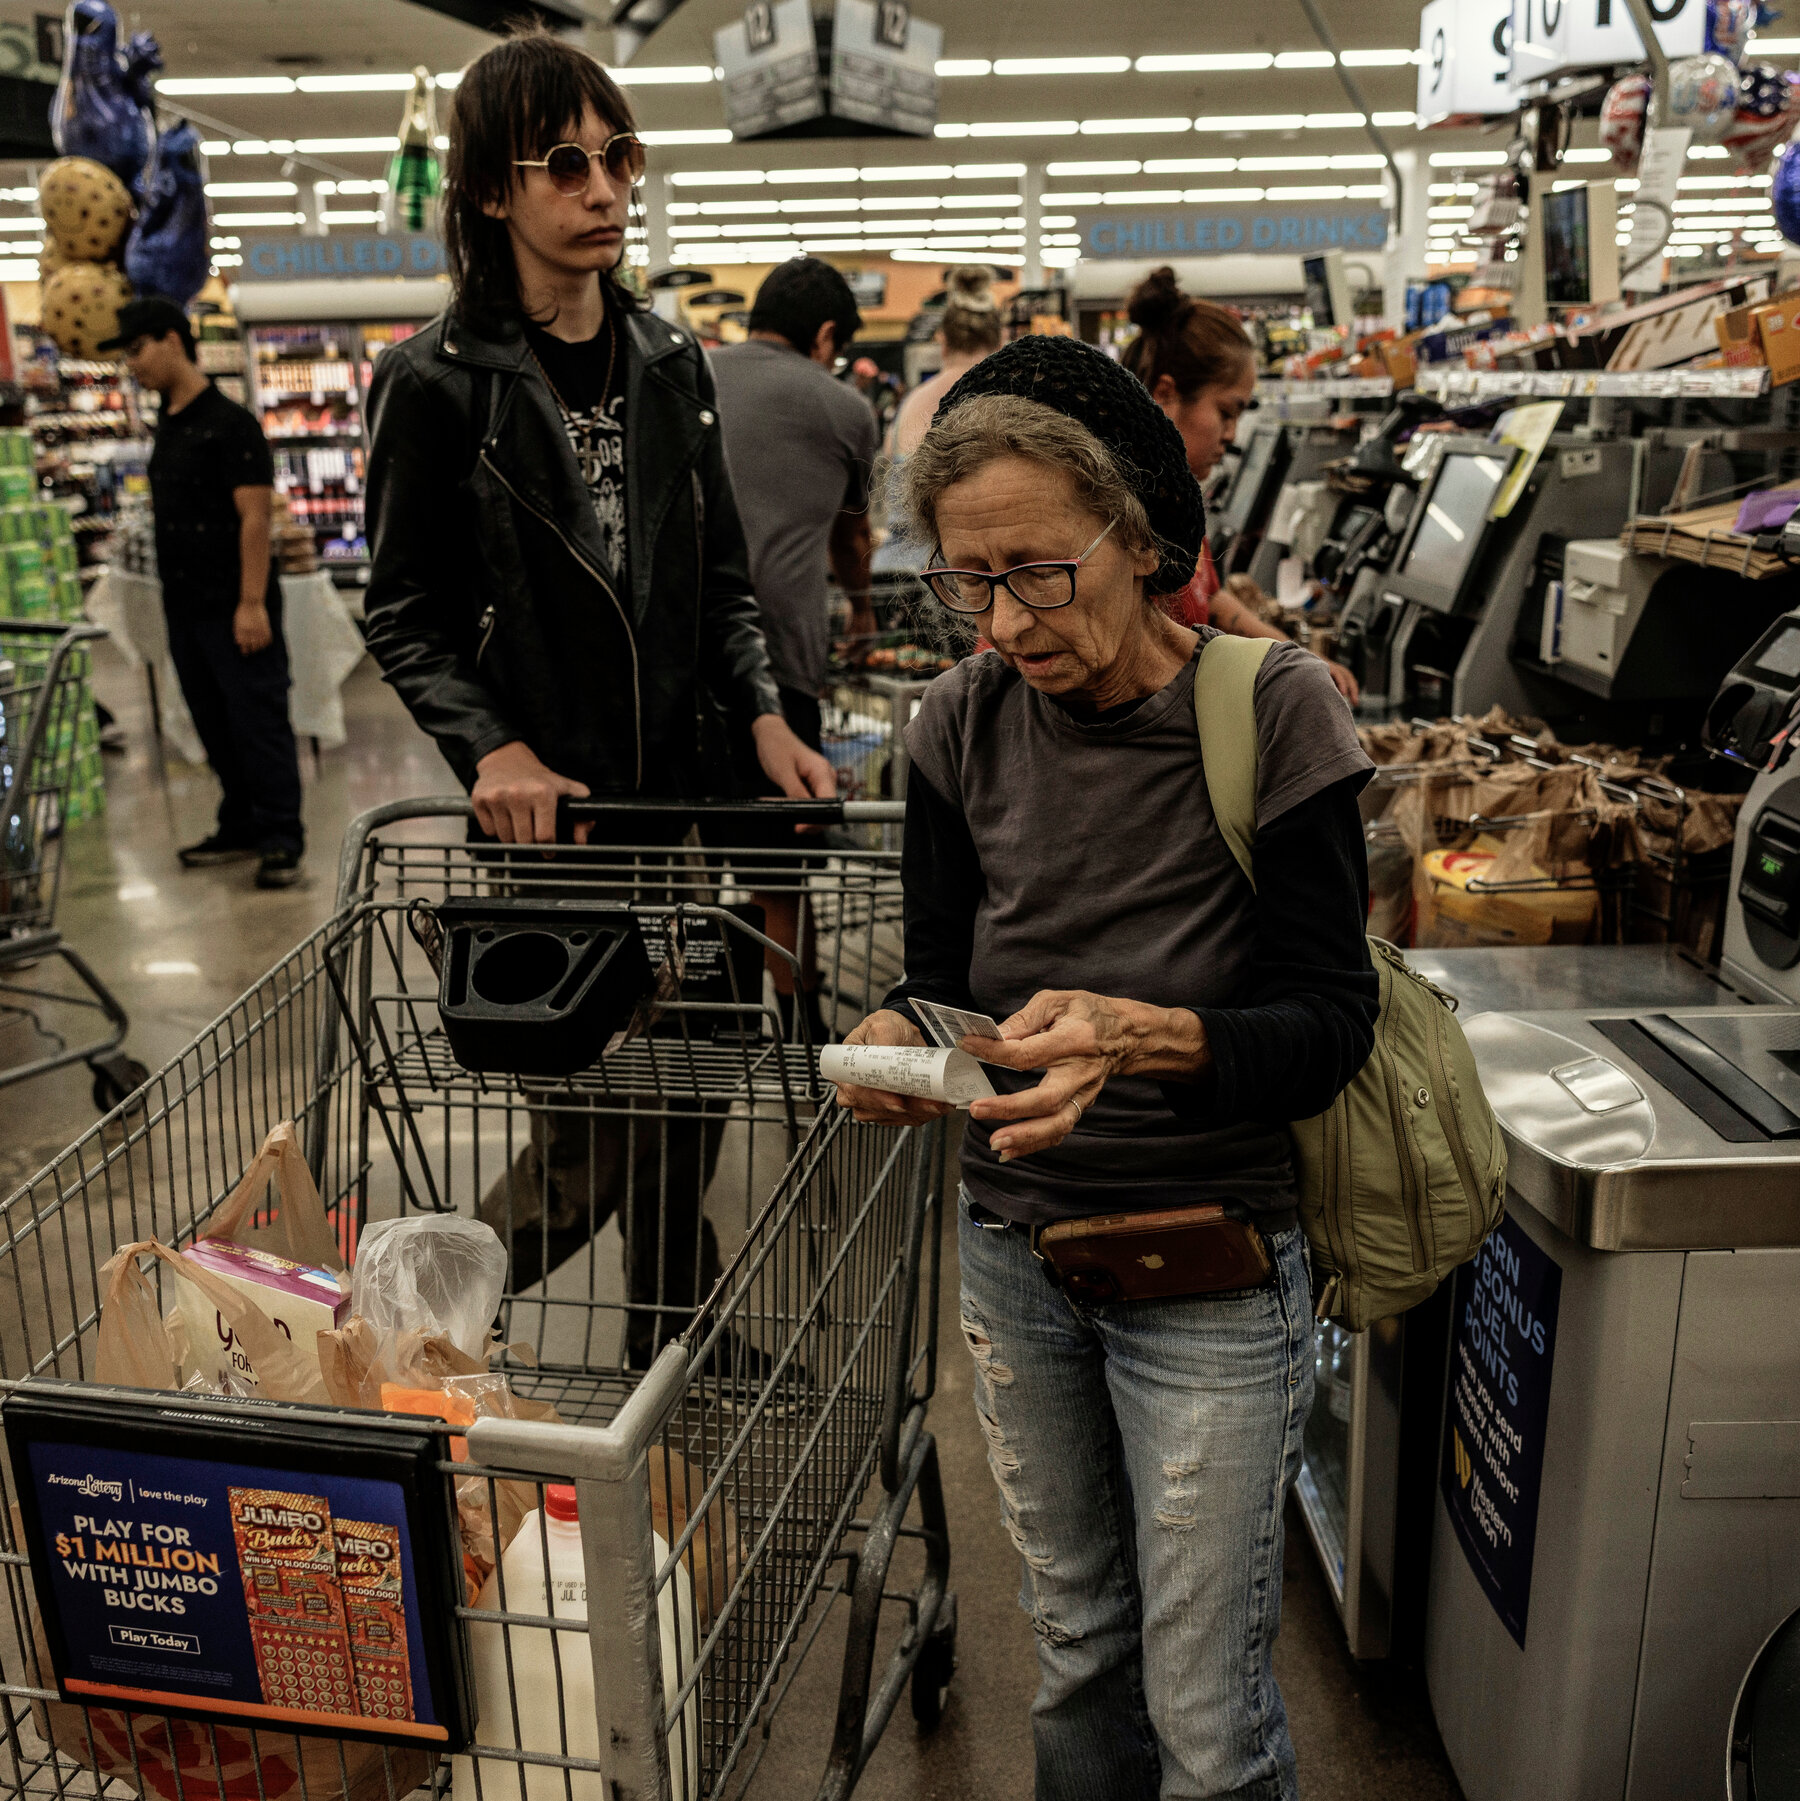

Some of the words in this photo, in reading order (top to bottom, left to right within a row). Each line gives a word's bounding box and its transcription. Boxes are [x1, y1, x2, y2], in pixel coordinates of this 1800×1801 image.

[1432, 28, 1445, 93] 9
[1089, 218, 1244, 252] CHILLED
[1253, 213, 1388, 248] DRINKS
[251, 240, 402, 275] CHILLED
[1485, 1231, 1520, 1287] ARN
[1473, 1278, 1511, 1359] FUEL
[1481, 1253, 1546, 1356] BONUS
[1465, 1302, 1519, 1407] POINTS
[1461, 1373, 1488, 1430] money
[1488, 1423, 1510, 1466] with
[1477, 1377, 1494, 1414] you
[1494, 1409, 1523, 1454] send
[48, 1473, 86, 1488] Arizona
[78, 1473, 123, 1502] Lottery
[139, 1487, 162, 1499] love
[163, 1490, 182, 1502] the
[184, 1494, 208, 1508] play
[1472, 1468, 1513, 1548] Western
[73, 1515, 133, 1539] PLAY
[140, 1523, 192, 1546] FOR
[238, 1506, 323, 1531] JUMBO
[1470, 1488, 1498, 1549] Union
[55, 1533, 86, 1559] $1
[95, 1538, 220, 1575] MILLION
[247, 1527, 315, 1549] Bucks
[335, 1535, 390, 1559] MBO
[62, 1560, 129, 1585] WITH
[133, 1570, 219, 1596] JUMBO
[244, 1555, 260, 1564] WIN
[260, 1557, 272, 1565] UP
[272, 1558, 283, 1567] TO
[338, 1555, 382, 1576] ucks
[104, 1589, 187, 1615] BUCKS
[561, 1589, 577, 1602] JUL
[120, 1630, 148, 1646] Play
[150, 1633, 190, 1650] Today
